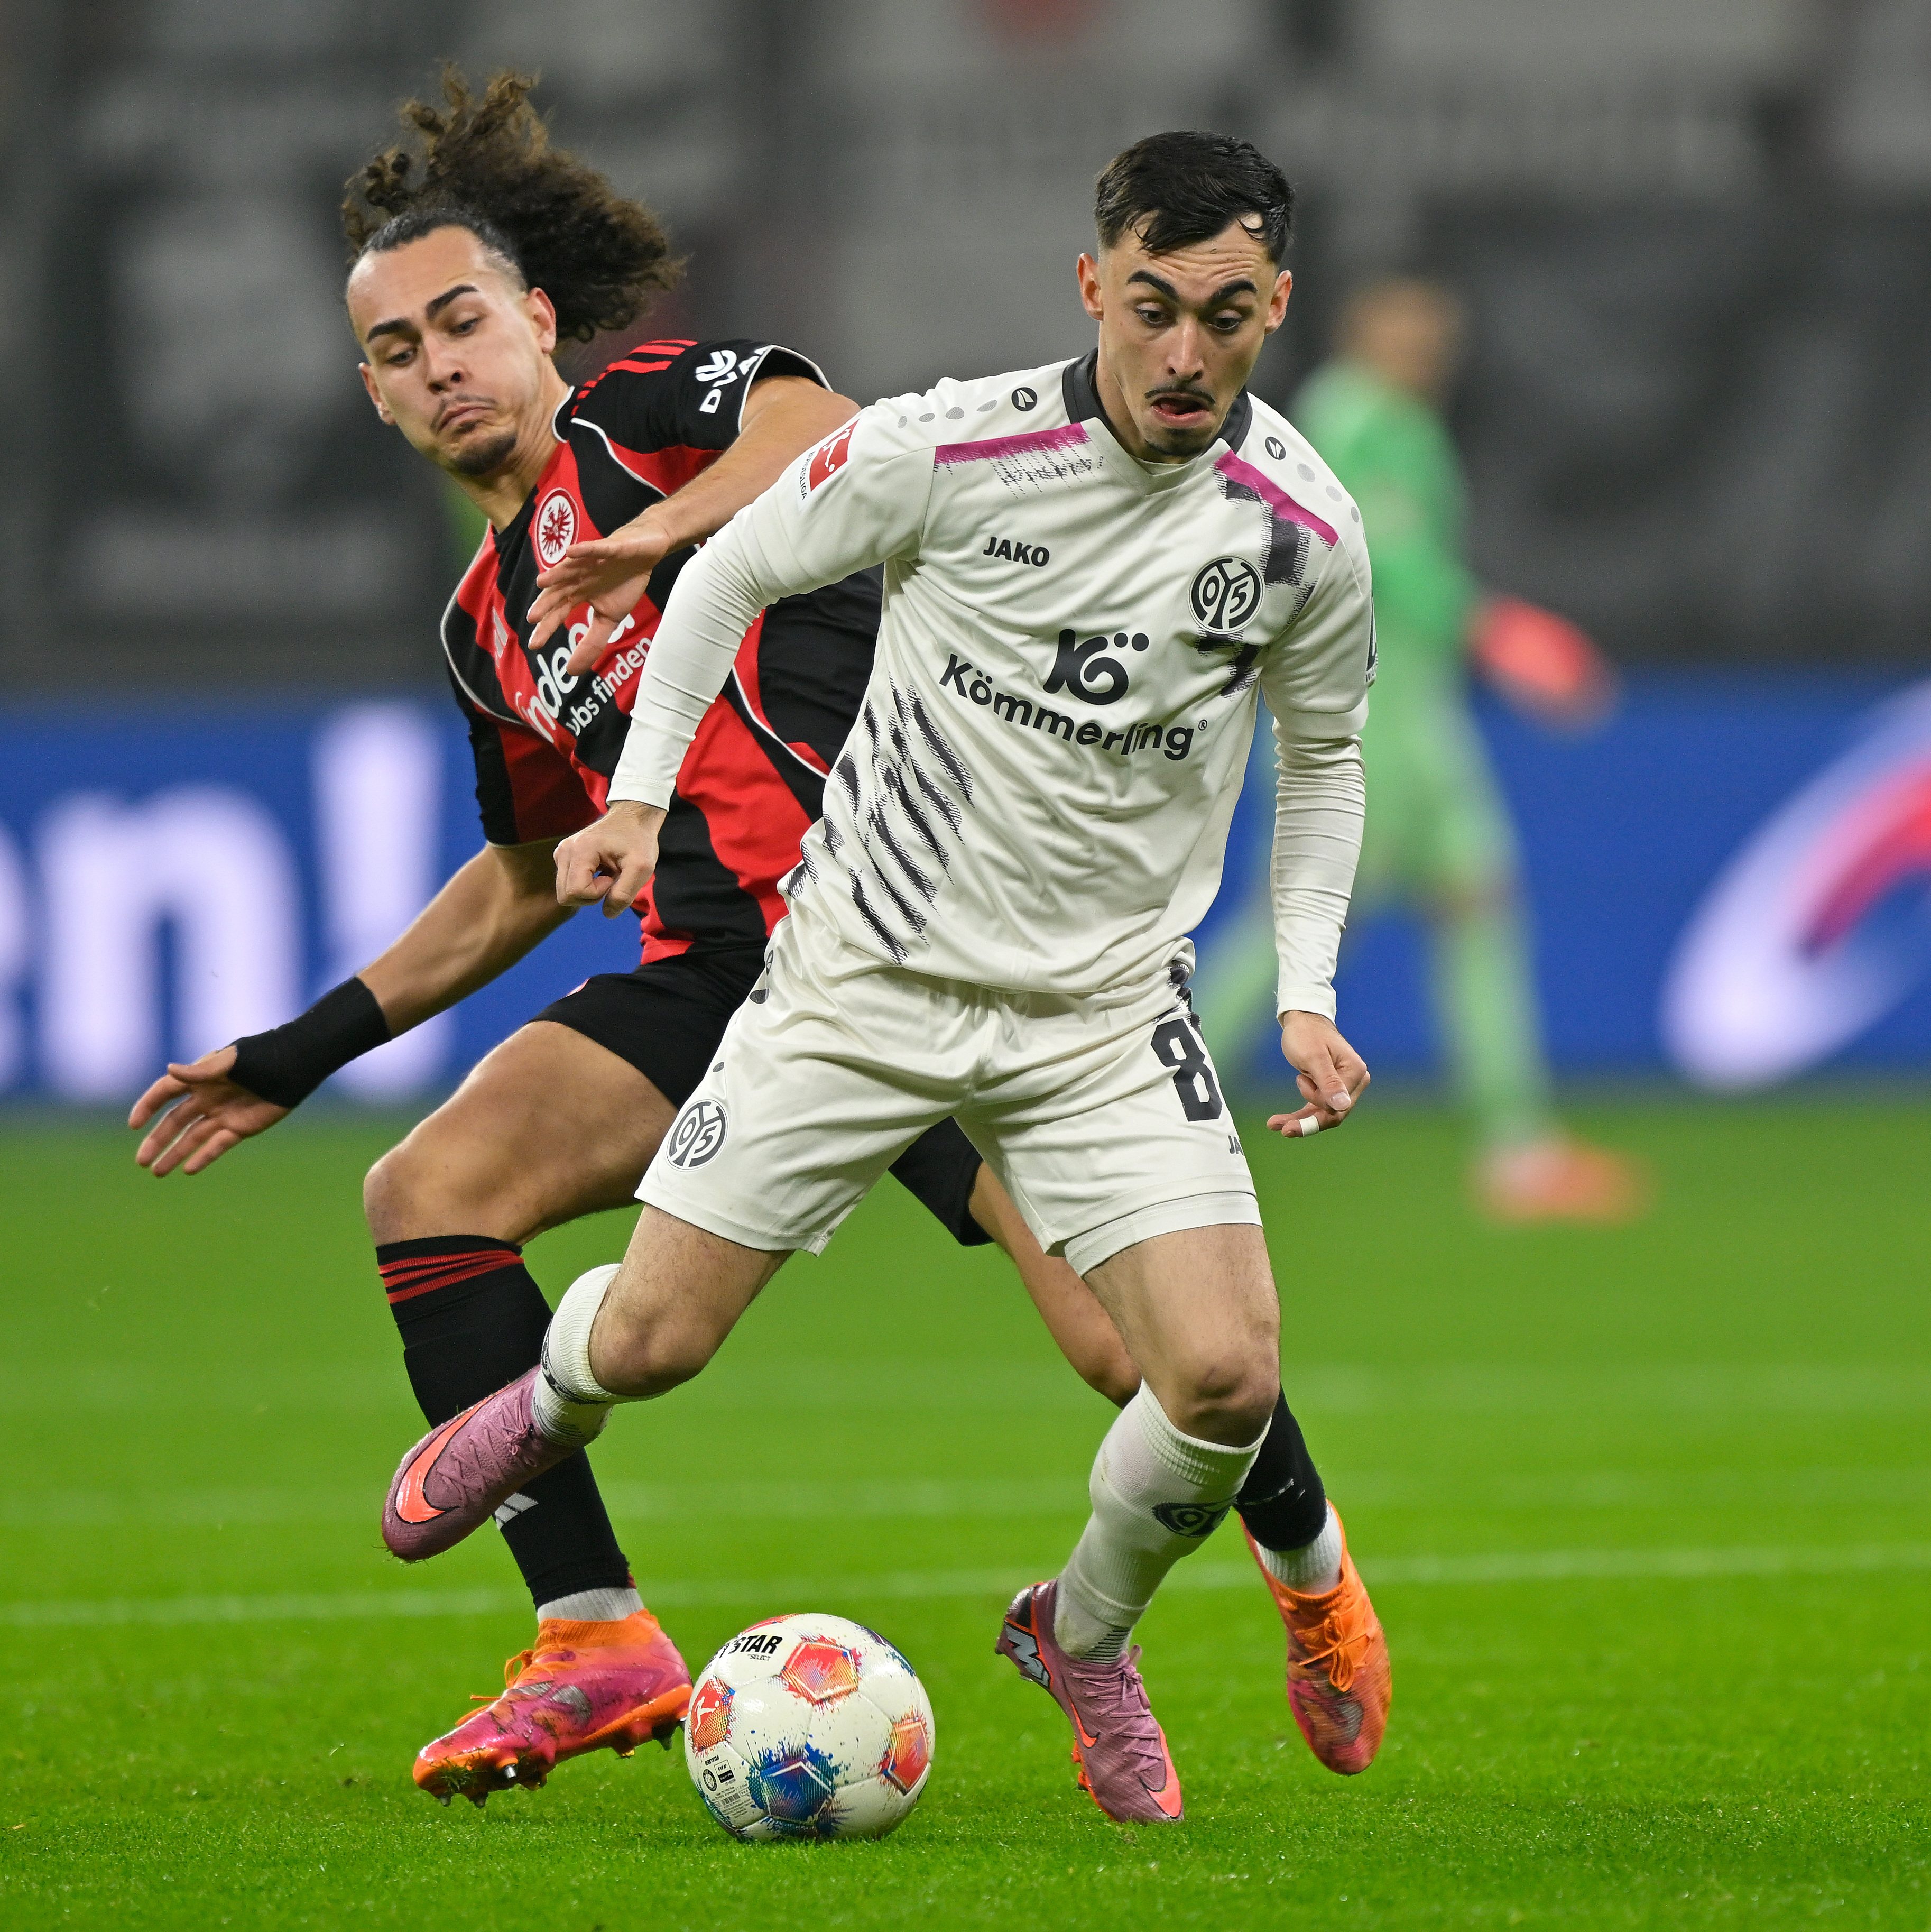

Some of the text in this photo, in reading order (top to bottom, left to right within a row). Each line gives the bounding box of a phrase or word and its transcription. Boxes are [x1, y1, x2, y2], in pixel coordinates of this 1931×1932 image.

[800, 451, 816, 500] BESLIGA
[982, 536, 1050, 567] JAKO
[515, 605, 635, 744] ndee
[591, 637, 653, 704] finden
[1150, 1018, 1223, 1123] 8
